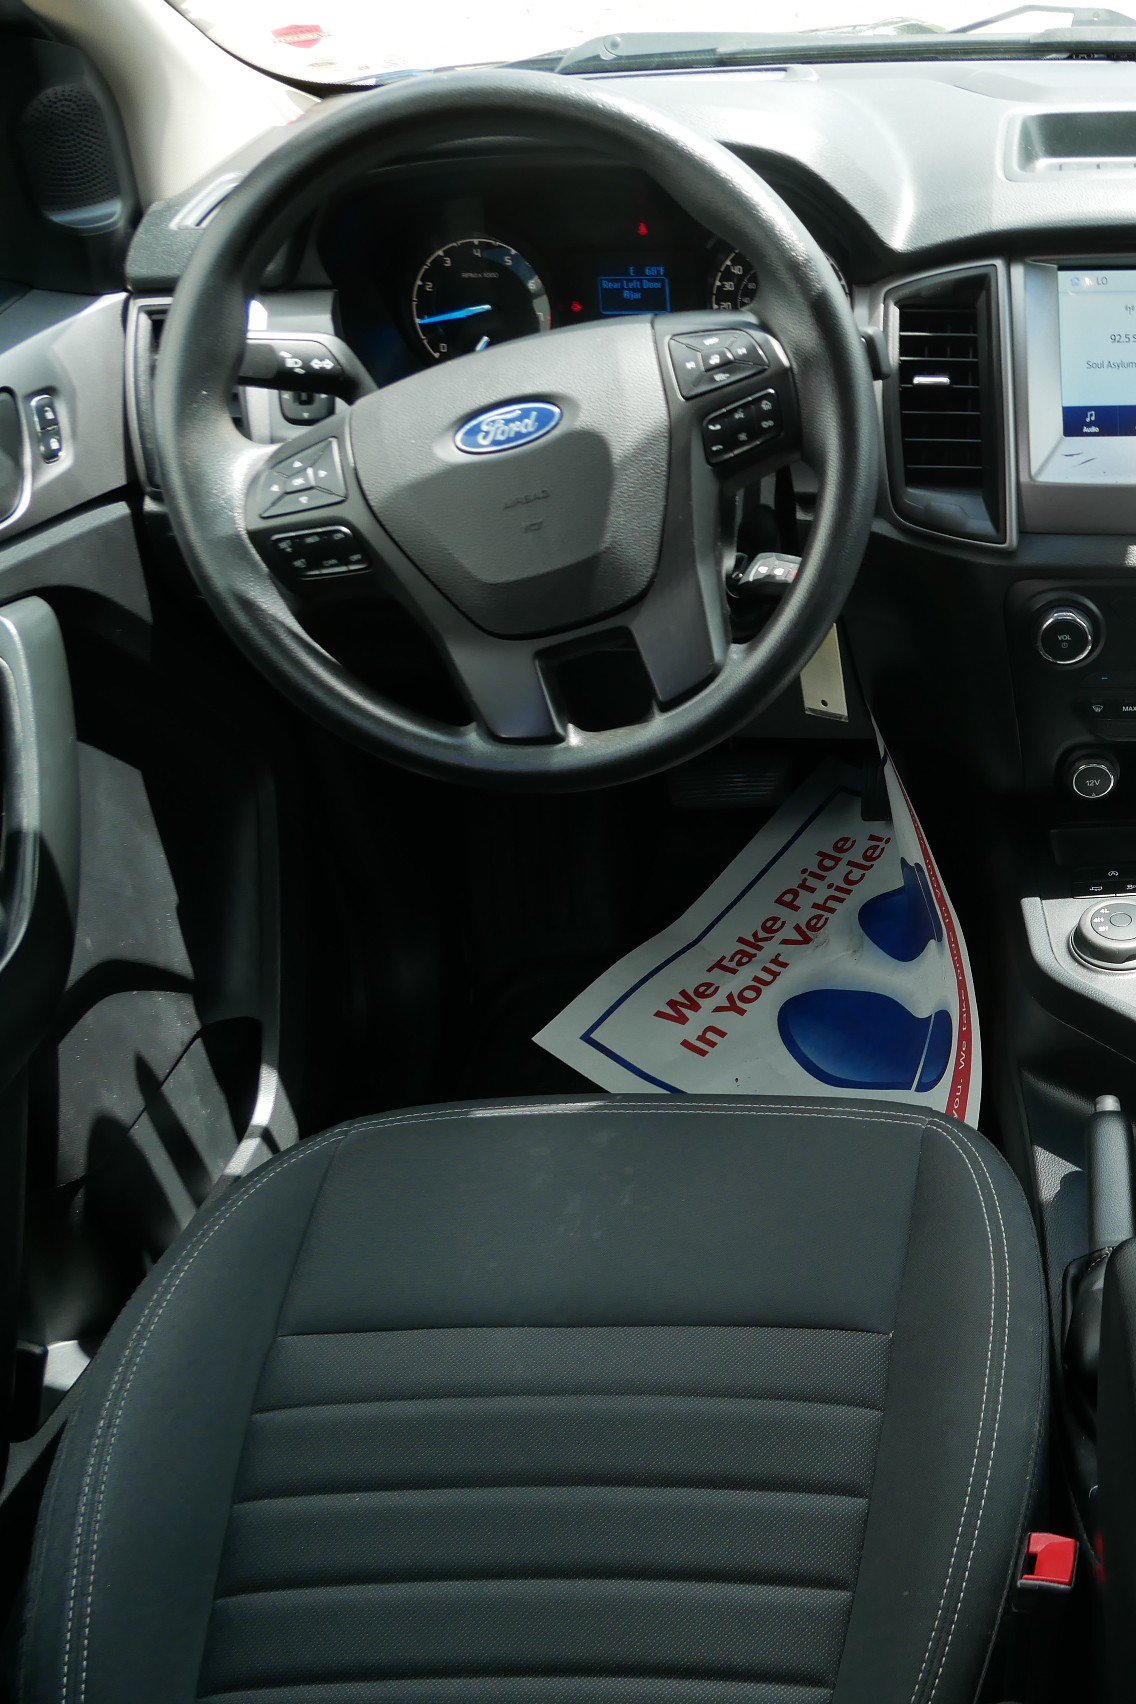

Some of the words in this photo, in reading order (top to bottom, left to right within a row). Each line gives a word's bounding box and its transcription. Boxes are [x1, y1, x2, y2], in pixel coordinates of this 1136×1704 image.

[473, 249, 481, 257] 4
[443, 258, 451, 266] 3
[505, 256, 512, 265] 5
[730, 265, 743, 275] 40
[528, 280, 536, 289] 6
[602, 280, 621, 288] Rear
[623, 280, 640, 288] Left
[643, 280, 662, 288] Door
[1096, 276, 1108, 286] LO
[426, 282, 433, 291] 2
[722, 282, 734, 291] 30
[623, 290, 642, 300] Ajar
[1110, 334, 1131, 343] 92.5
[440, 344, 447, 352] 0
[1086, 360, 1104, 369] Soul
[1107, 360, 1136, 370] Asylum
[477, 409, 538, 446] Ford
[1086, 779, 1100, 787] 12V
[653, 981, 720, 1025] We
[706, 916, 786, 975] Take
[774, 836, 856, 912] Pride
[679, 1025, 728, 1058] In
[711, 953, 790, 1017] Your
[779, 833, 891, 946] Vehicle!
[958, 1040, 967, 1070] We
